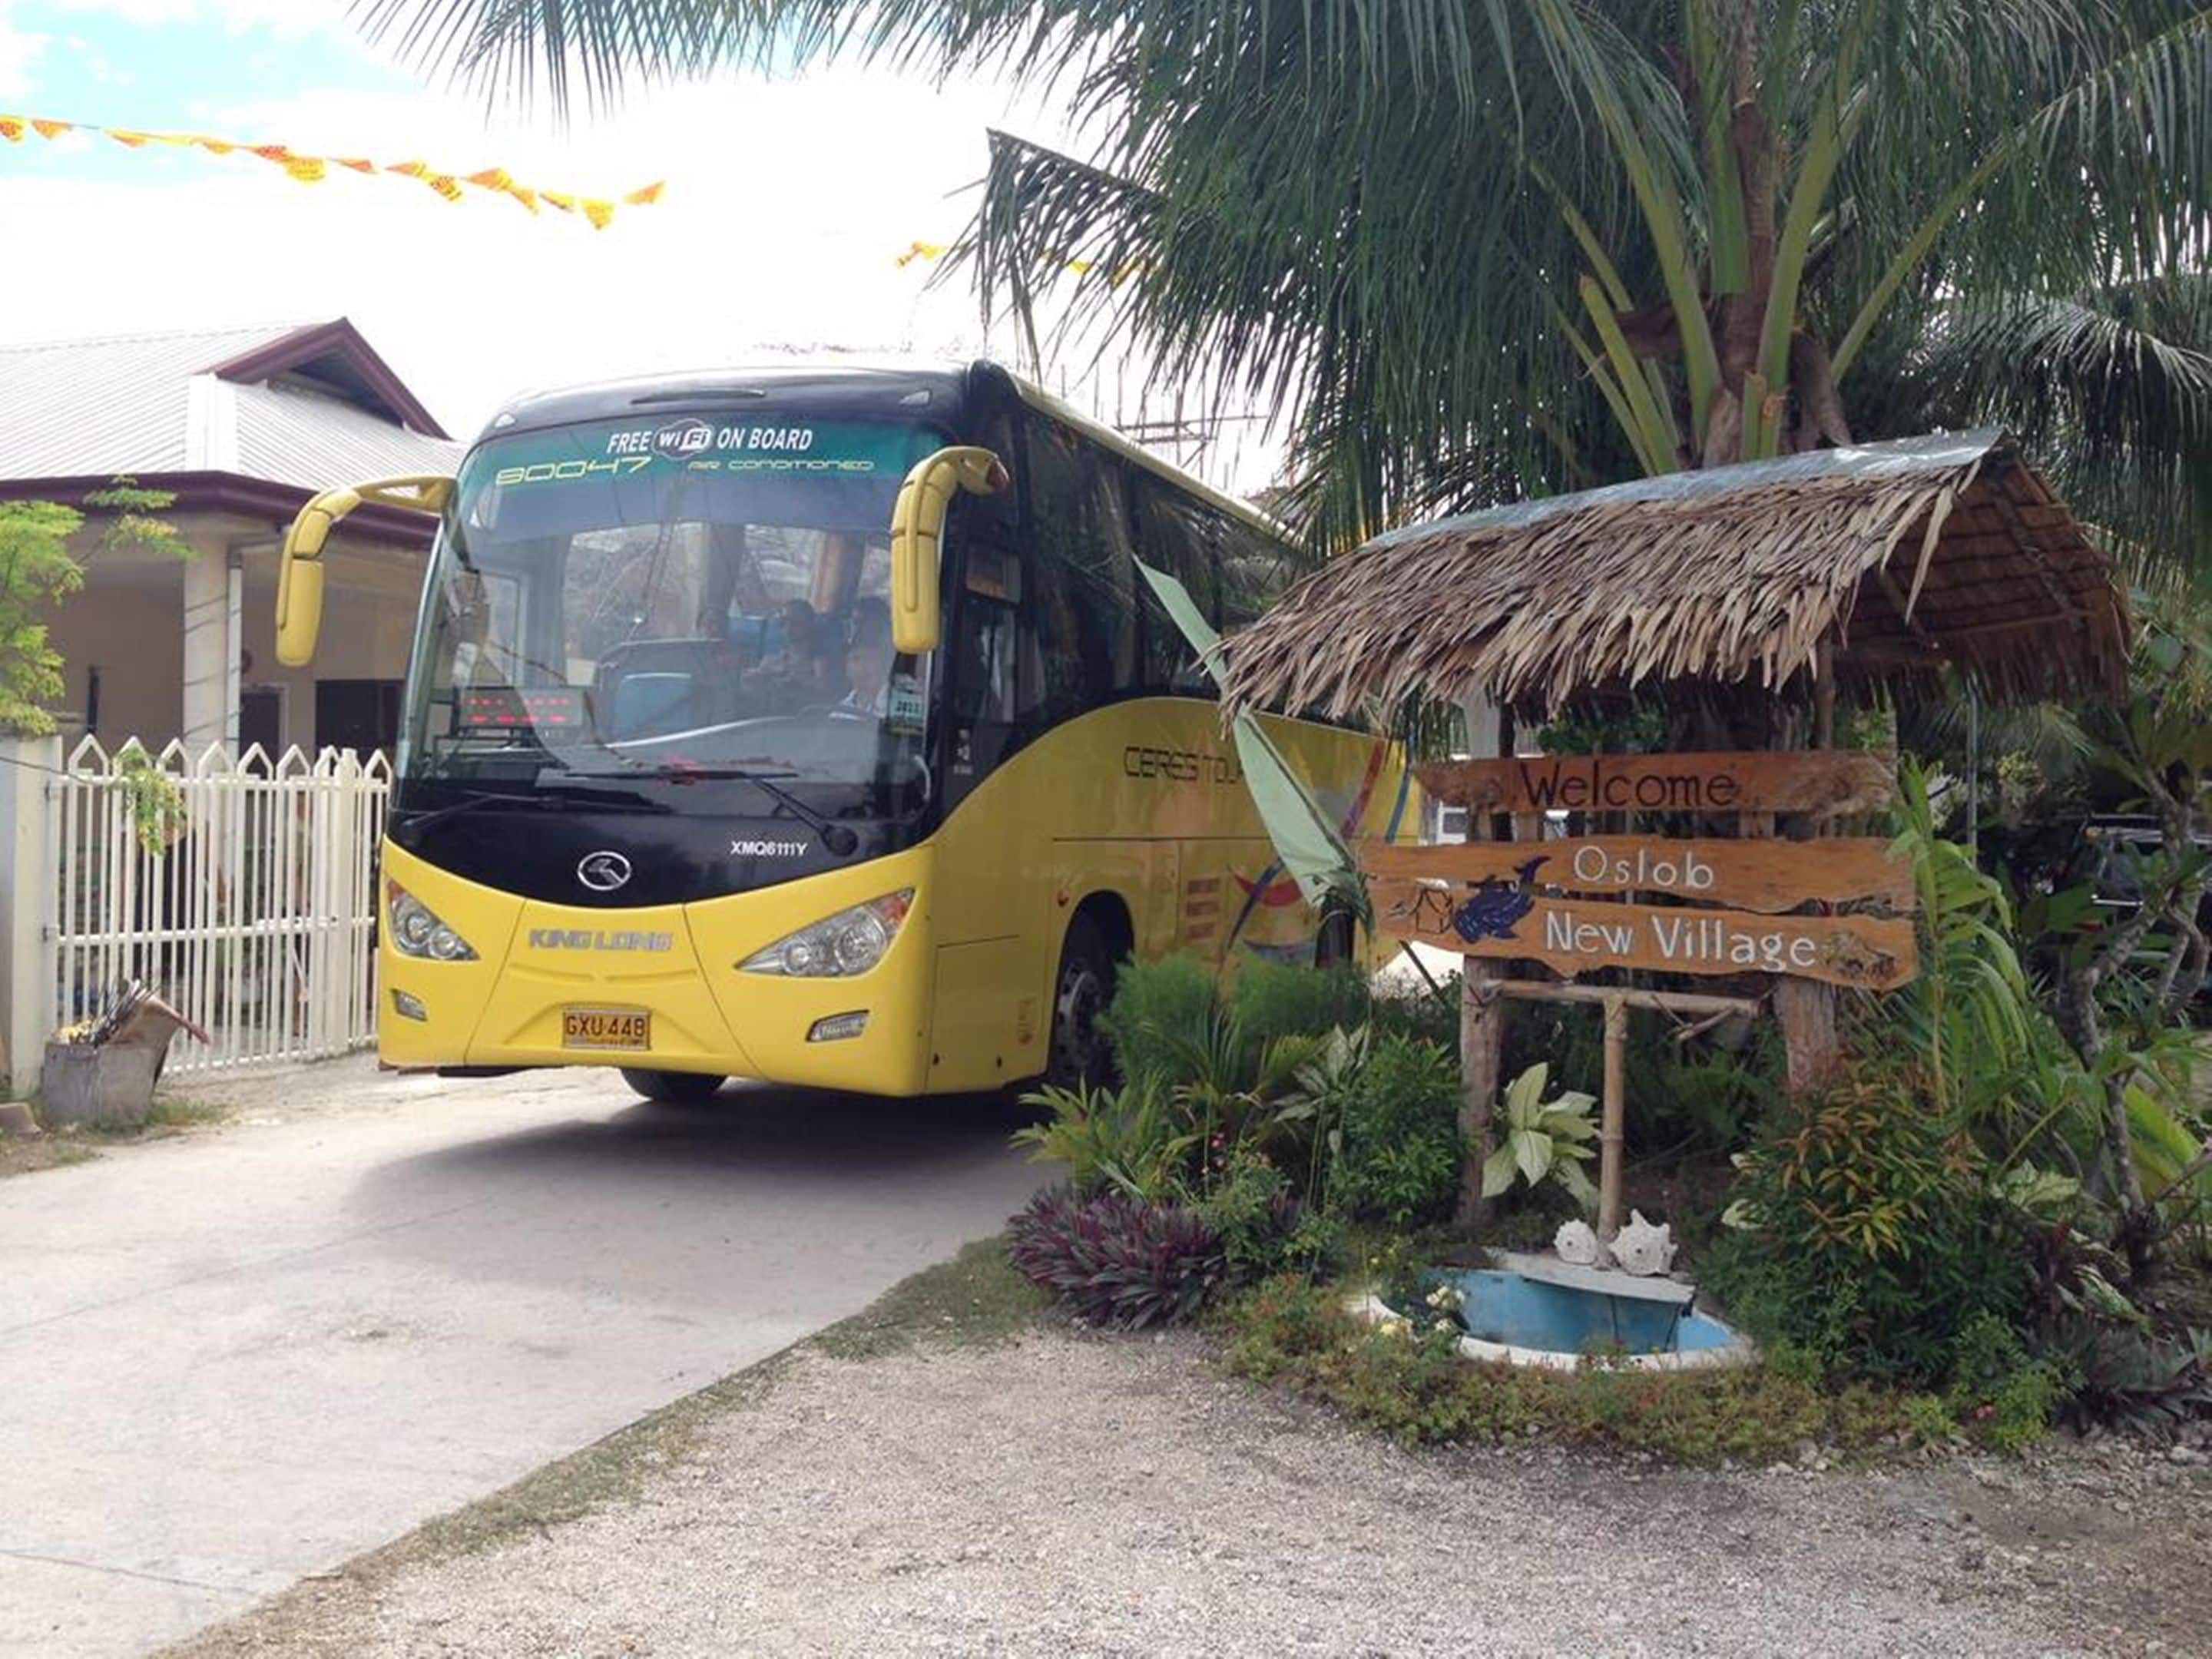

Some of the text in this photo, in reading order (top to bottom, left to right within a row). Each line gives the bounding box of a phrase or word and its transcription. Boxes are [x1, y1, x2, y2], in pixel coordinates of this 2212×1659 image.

[605, 430, 653, 454] FREE
[716, 427, 745, 449] ON
[747, 428, 813, 451] BOARD
[1519, 760, 1739, 807] Welcome
[730, 840, 809, 857] XMQ6111Y
[1574, 845, 1715, 889] Oslob
[528, 929, 674, 951] KING LONG
[1545, 909, 1817, 972] New Village
